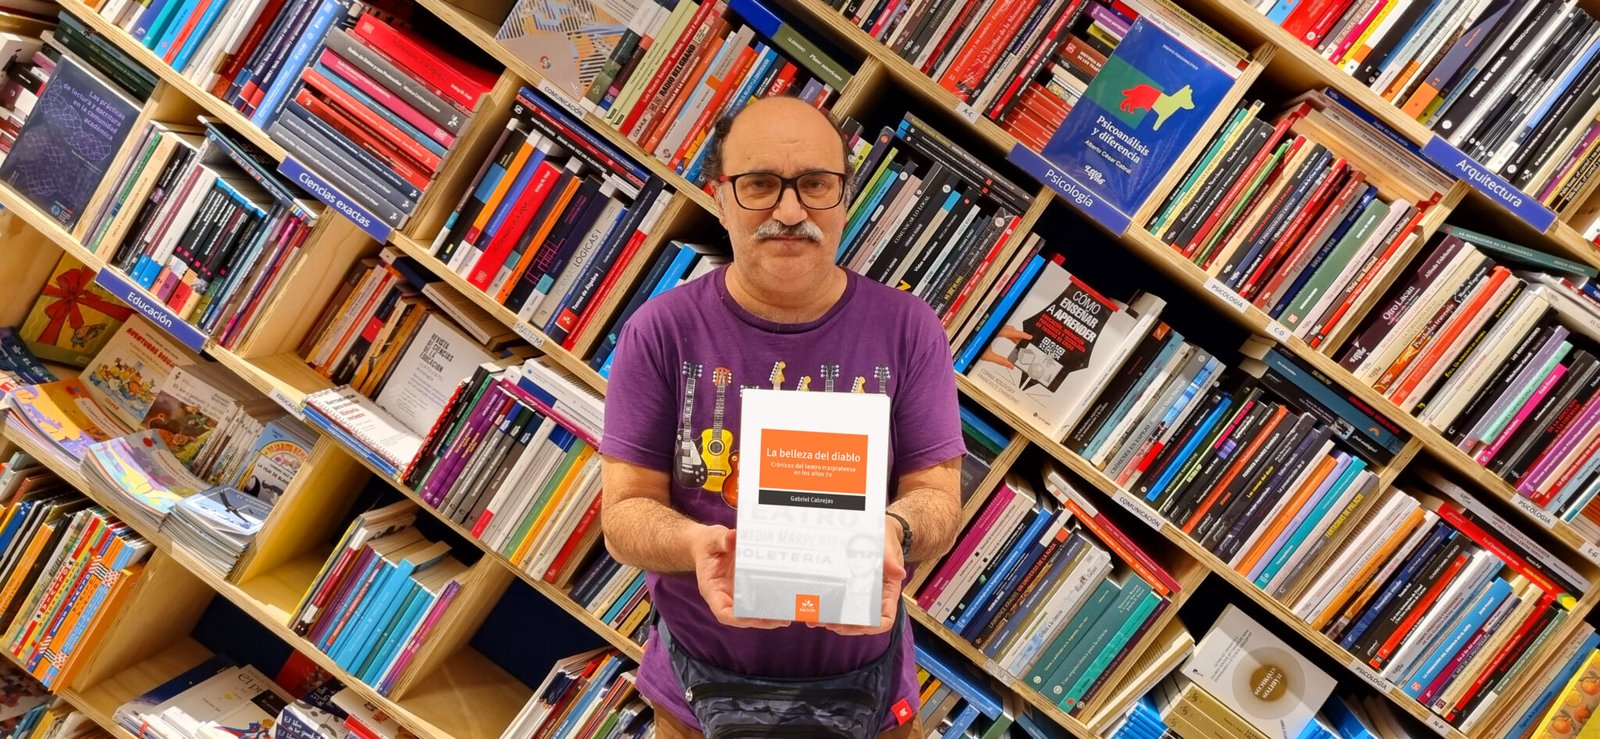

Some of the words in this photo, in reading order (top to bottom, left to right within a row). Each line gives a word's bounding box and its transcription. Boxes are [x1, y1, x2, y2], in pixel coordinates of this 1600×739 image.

[1335, 34, 1344, 43] EL
[1341, 20, 1355, 37] ALMA
[1353, 12, 1362, 22] DE
[658, 75, 675, 97] RADIO
[670, 43, 697, 78] BELGRANO
[1468, 78, 1486, 99] FINAL
[1483, 70, 1493, 81] DE
[62, 82, 72, 91] de
[69, 88, 90, 104] lectura
[87, 100, 96, 110] y
[94, 106, 122, 127] escritura
[71, 99, 81, 109] en
[85, 109, 118, 134] comunidad
[87, 91, 100, 102] Las
[97, 98, 127, 121] prácticas
[542, 85, 584, 117] COMUNICACIÓN
[81, 116, 114, 141] académica
[1090, 126, 1100, 137] y
[1095, 114, 1151, 156] Psicoanálisis
[1083, 139, 1102, 154] Alberto
[1100, 150, 1116, 163] César
[1114, 160, 1132, 174] Cabral
[1097, 129, 1142, 164] diferencia
[1041, 167, 1096, 209] Psicología
[1457, 159, 1522, 207] Arquitectura
[296, 171, 338, 203] Ciencias
[333, 197, 372, 228] exactas
[893, 216, 915, 244] COMUNICAR
[917, 194, 930, 211] LOCAL
[1262, 212, 1284, 239] PSICOANÁLISIS
[570, 231, 599, 268] LÓGICAS
[913, 260, 924, 272] Vidas
[921, 240, 938, 262] mediáticas
[571, 295, 583, 310] Temas
[583, 271, 600, 291] Álgebra
[1345, 279, 1358, 294] Vivir
[1355, 272, 1365, 282] con
[124, 290, 175, 329] Educación
[1059, 294, 1100, 328] ENSEÑAR
[1071, 287, 1103, 315] CÓMO
[1381, 301, 1399, 321] Otro
[1393, 282, 1415, 307] Lacan
[1045, 302, 1057, 315] A
[1052, 307, 1097, 343] APRENDER
[1413, 321, 1436, 349] Parábolas
[1433, 301, 1454, 326] travestis
[124, 326, 160, 355] AVENTURAS
[430, 332, 450, 349] REVISTA
[431, 343, 454, 362] CIENCIAS
[418, 351, 444, 373] EDUCACION
[1537, 383, 1547, 395] Erich
[767, 448, 777, 458] La
[779, 448, 813, 459] belleza
[815, 451, 829, 461] del
[831, 452, 861, 463] diablo
[1108, 447, 1131, 475] CRÍMENES
[1128, 441, 1137, 450] EN
[1133, 423, 1150, 443] ESPEJO
[771, 461, 795, 470] Crónicas
[1281, 467, 1299, 489] presentación
[810, 496, 834, 505] Cabrejas
[1117, 495, 1162, 528] COMUNICACIÓN
[1342, 508, 1351, 517] DE
[1346, 492, 1364, 512] PALACIO
[1324, 512, 1347, 539] FANTASMAS
[39, 568, 69, 609] OLIVIA
[67, 573, 90, 607] OLIVIA
[987, 605, 1007, 629] LAWRENCE
[1003, 589, 1019, 608] KRAUSS
[1016, 583, 1025, 592] UN
[1022, 563, 1040, 586] UNIVERSO
[1044, 541, 1057, 556] NADA
